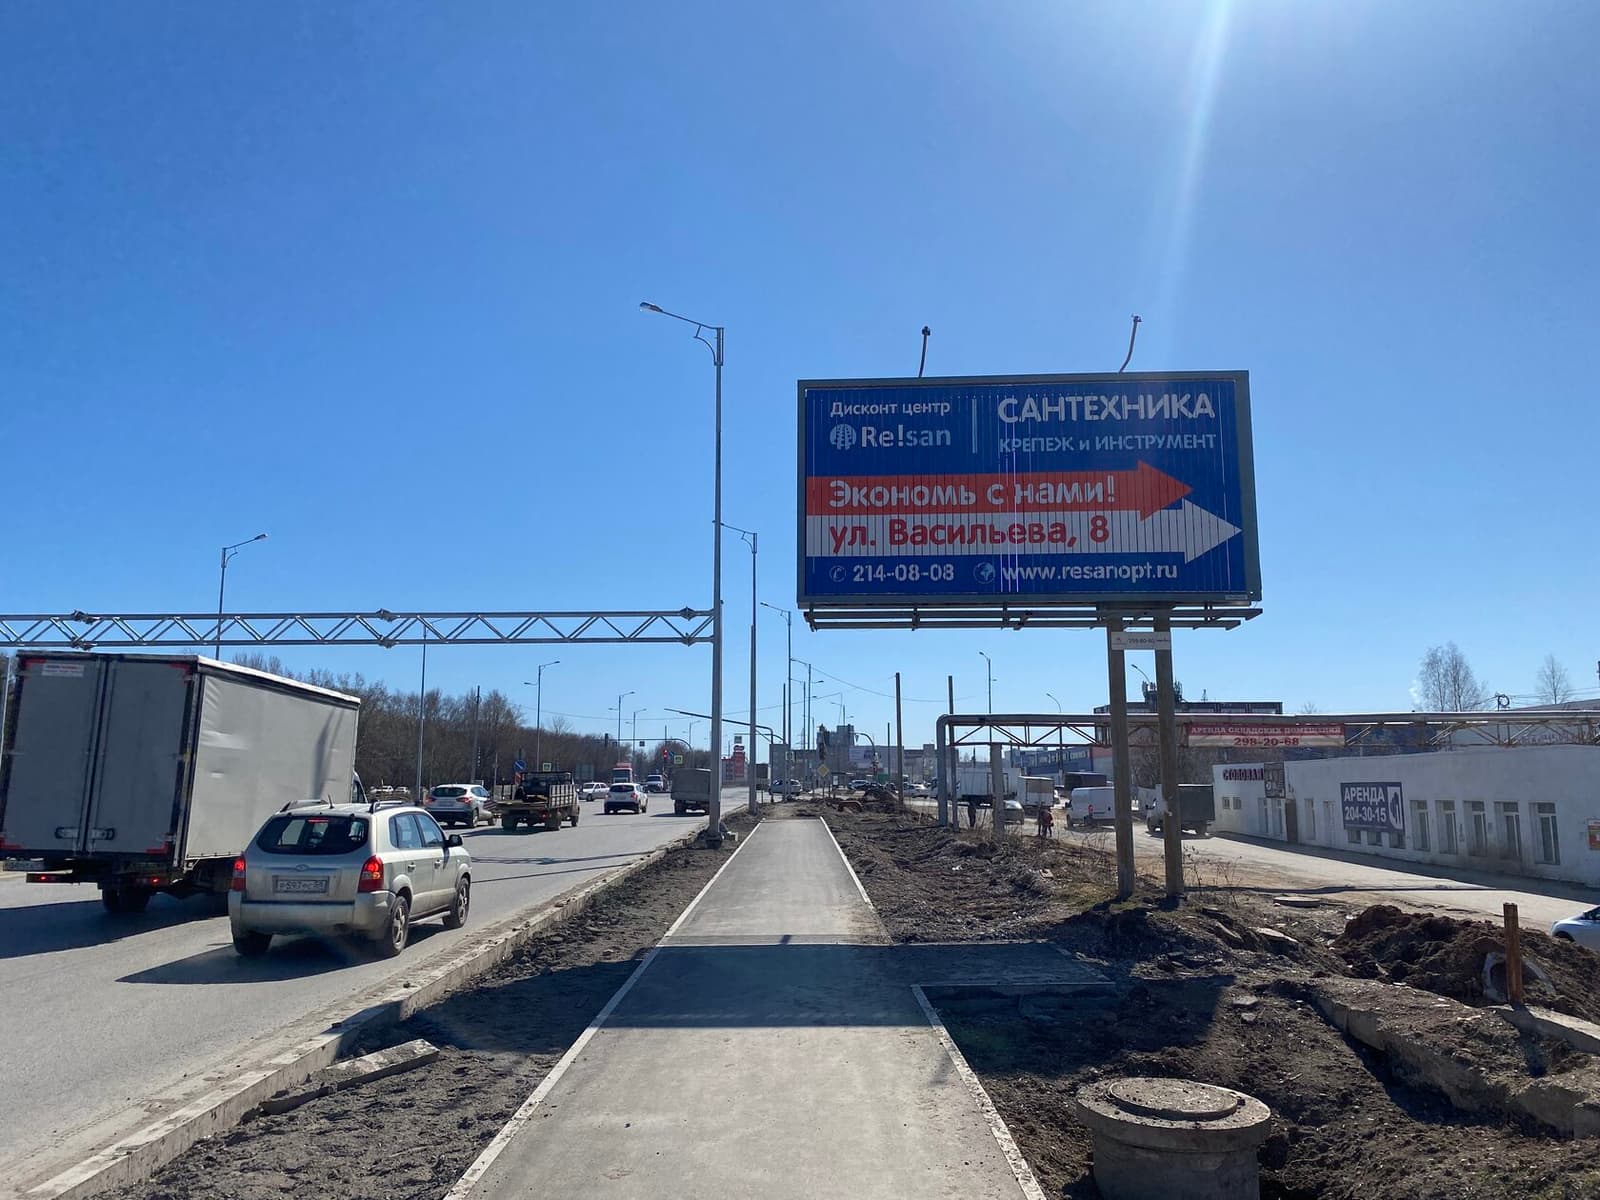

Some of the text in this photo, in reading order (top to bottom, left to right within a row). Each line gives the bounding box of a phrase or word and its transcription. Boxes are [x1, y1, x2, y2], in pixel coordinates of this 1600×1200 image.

[830, 401, 951, 418] Дисконт центр
[997, 393, 1216, 423] САНТЕХНИКА
[861, 424, 952, 448] Re!san
[999, 433, 1217, 453] КРЕПЕЖ и ИНСТРУМЕНТ
[829, 475, 1115, 508] Экономь с нами!
[829, 515, 1110, 554] ул. Васильева, 8
[852, 563, 955, 583] 214-08-08
[1002, 562, 1178, 583] www.resanopt.ru
[1234, 737, 1300, 746] 298-20-68
[1343, 787, 1385, 805] АРЕНДА
[1344, 806, 1387, 822] 204-30-15
